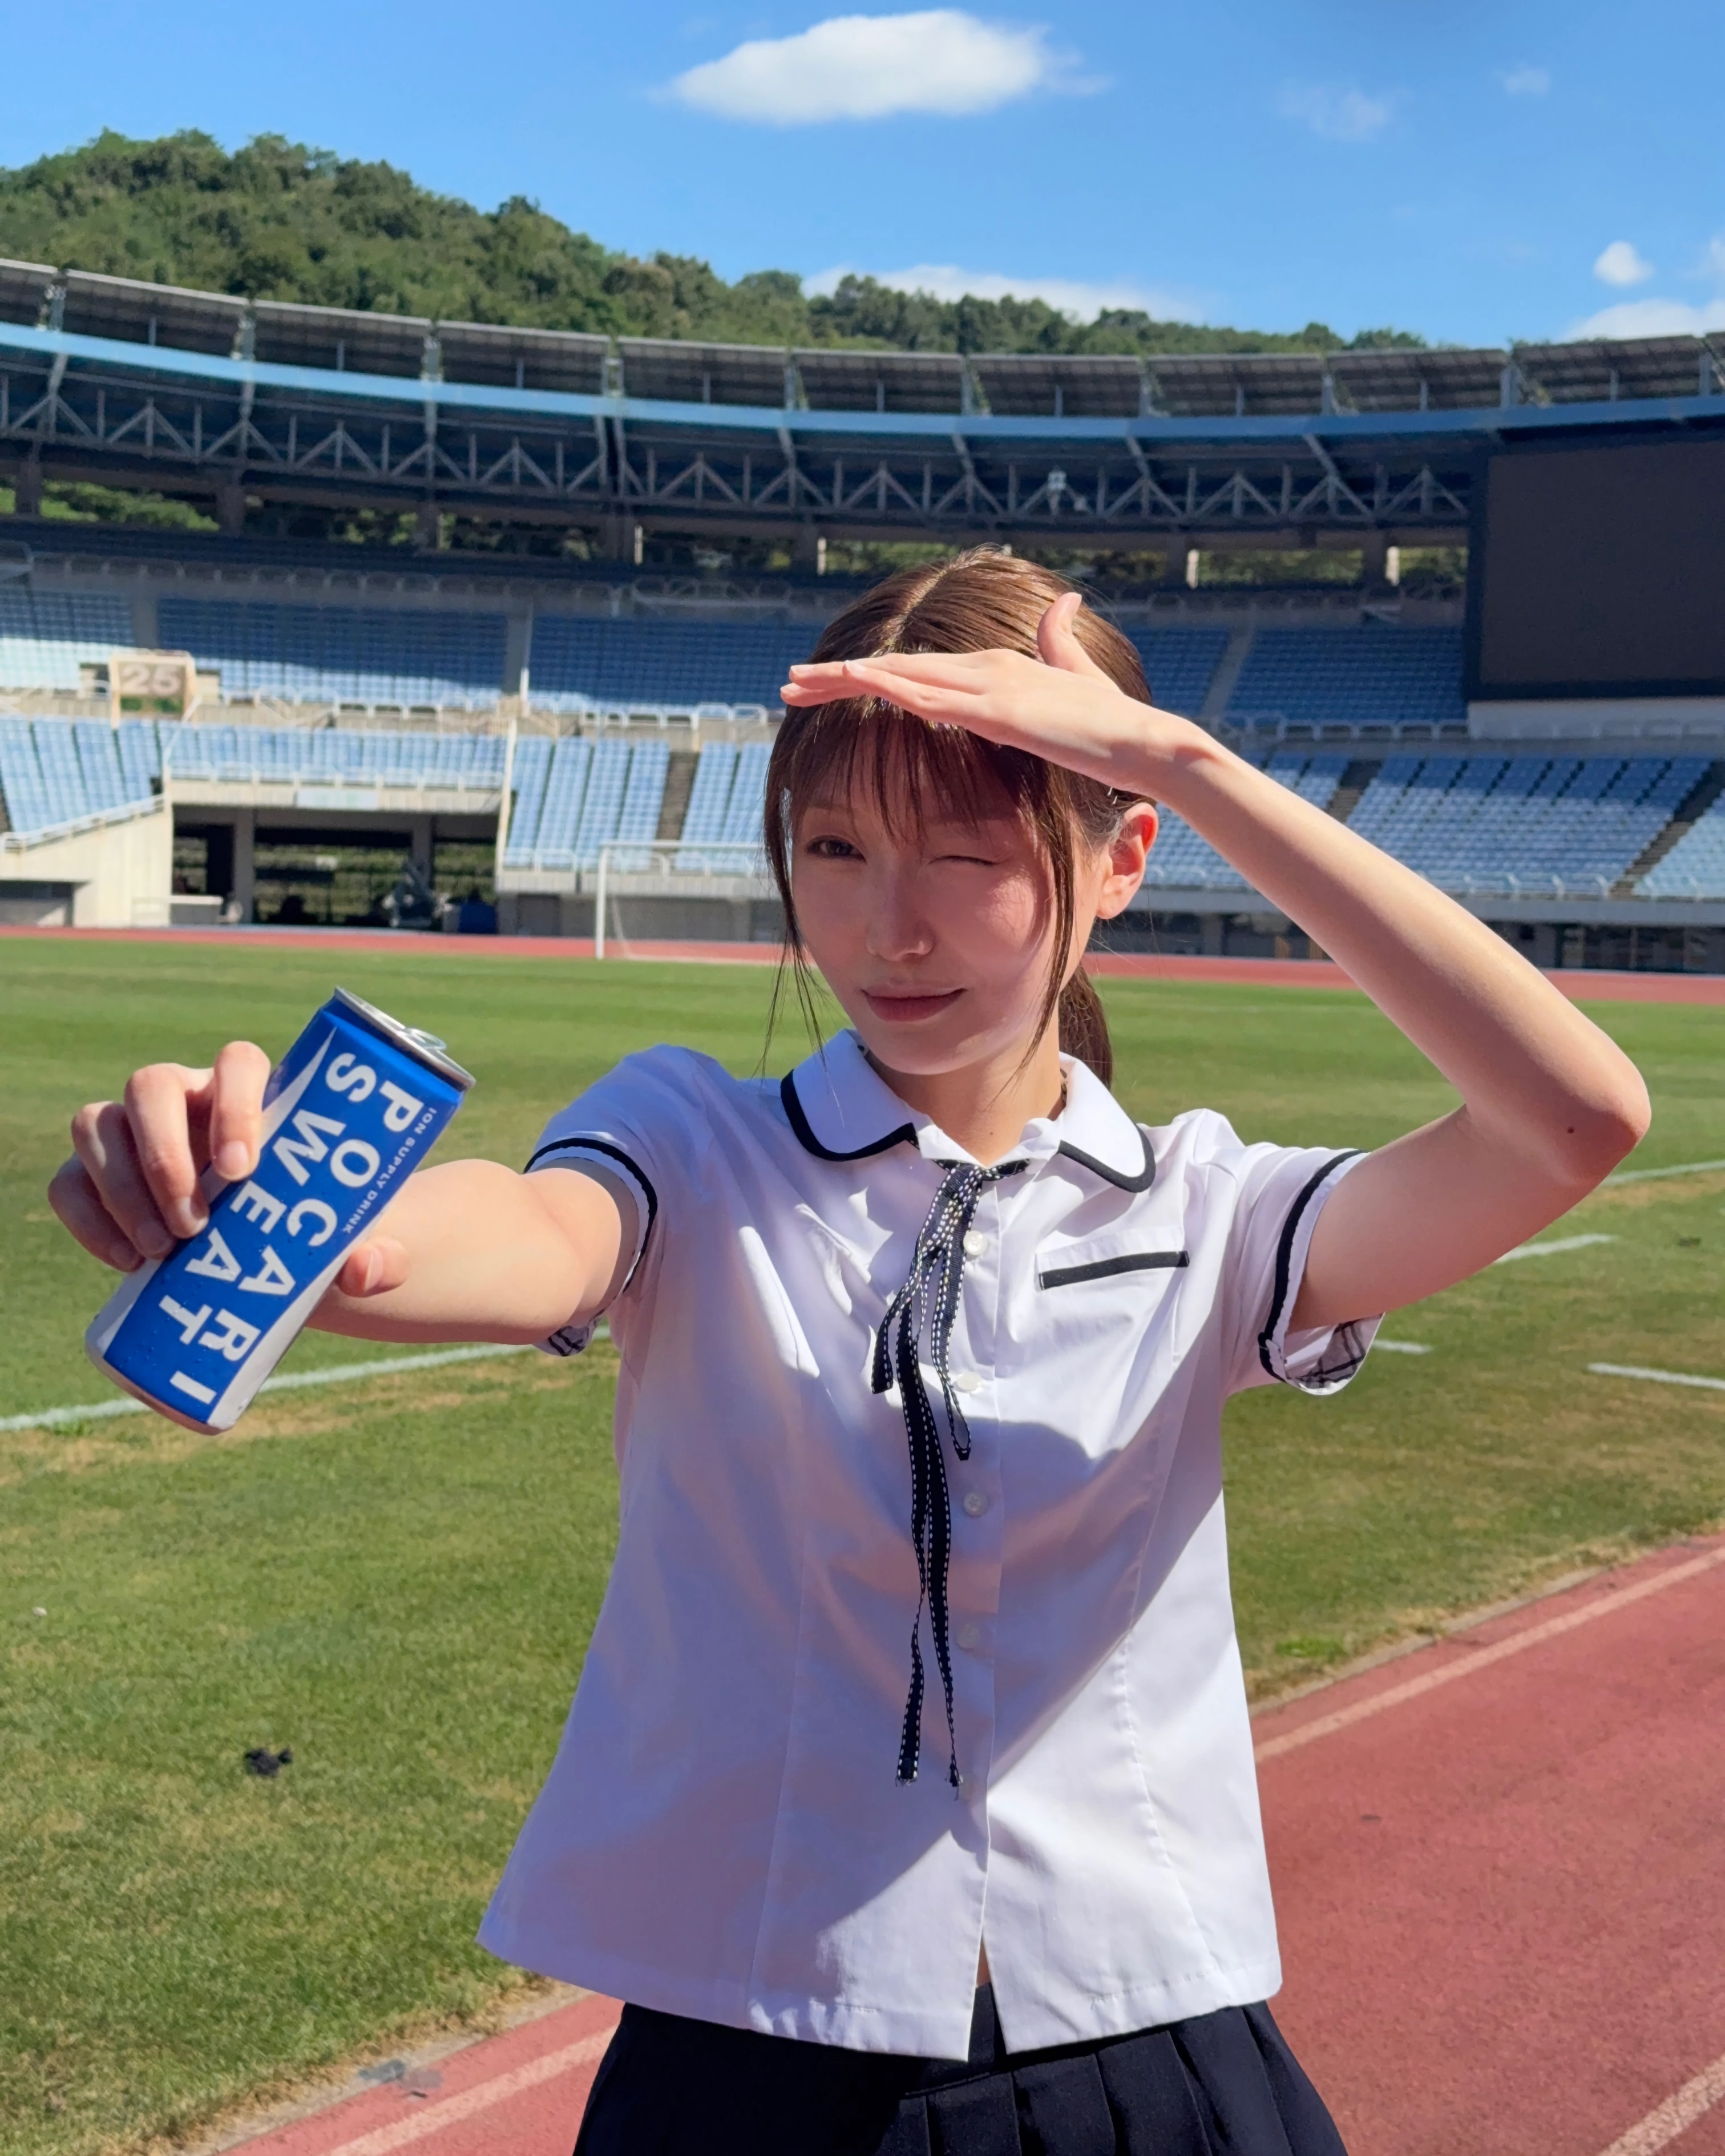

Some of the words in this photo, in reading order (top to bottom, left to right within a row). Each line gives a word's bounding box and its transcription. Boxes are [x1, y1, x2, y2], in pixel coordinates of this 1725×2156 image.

[414, 1108, 437, 1134] ION
[376, 1137, 415, 1189] SUPPLY
[159, 1053, 377, 1345] SWEAT
[342, 1190, 378, 1234] DRINK
[169, 1080, 425, 1405] POCARI
